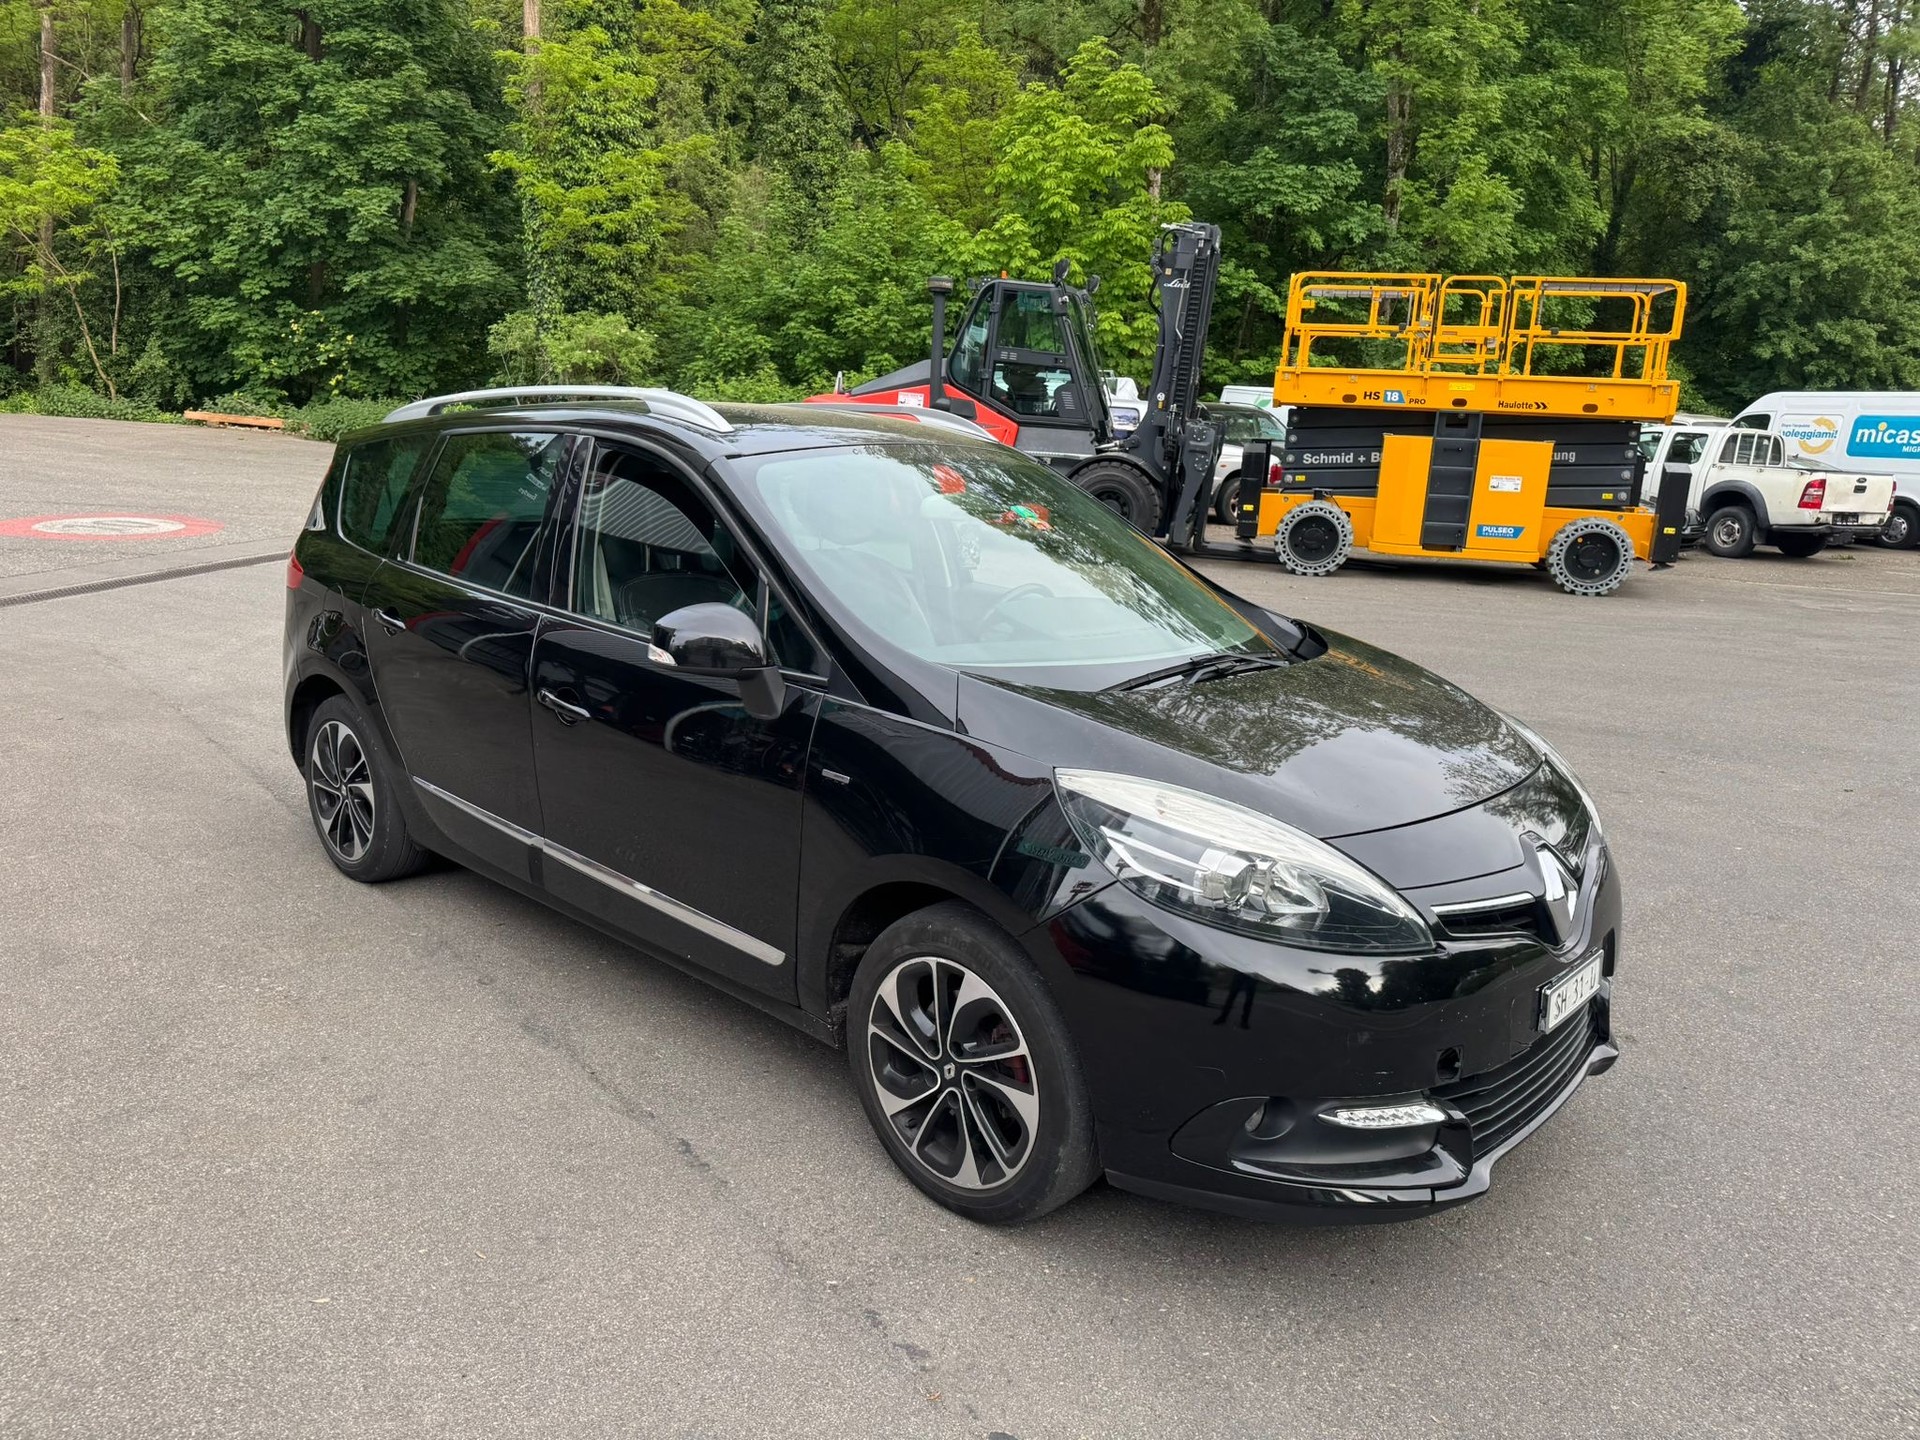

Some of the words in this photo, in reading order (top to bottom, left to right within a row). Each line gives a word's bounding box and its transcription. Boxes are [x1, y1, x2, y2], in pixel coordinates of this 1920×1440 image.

[1163, 278, 1191, 288] Lind
[1363, 391, 1381, 401] HS
[1386, 391, 1399, 402] 18
[1498, 400, 1534, 409] Haulotte
[1303, 452, 1354, 464] Schmid
[1358, 455, 1366, 463] +
[1370, 452, 1381, 463] B
[1551, 451, 1576, 463] ung
[1554, 987, 1568, 1020] SH
